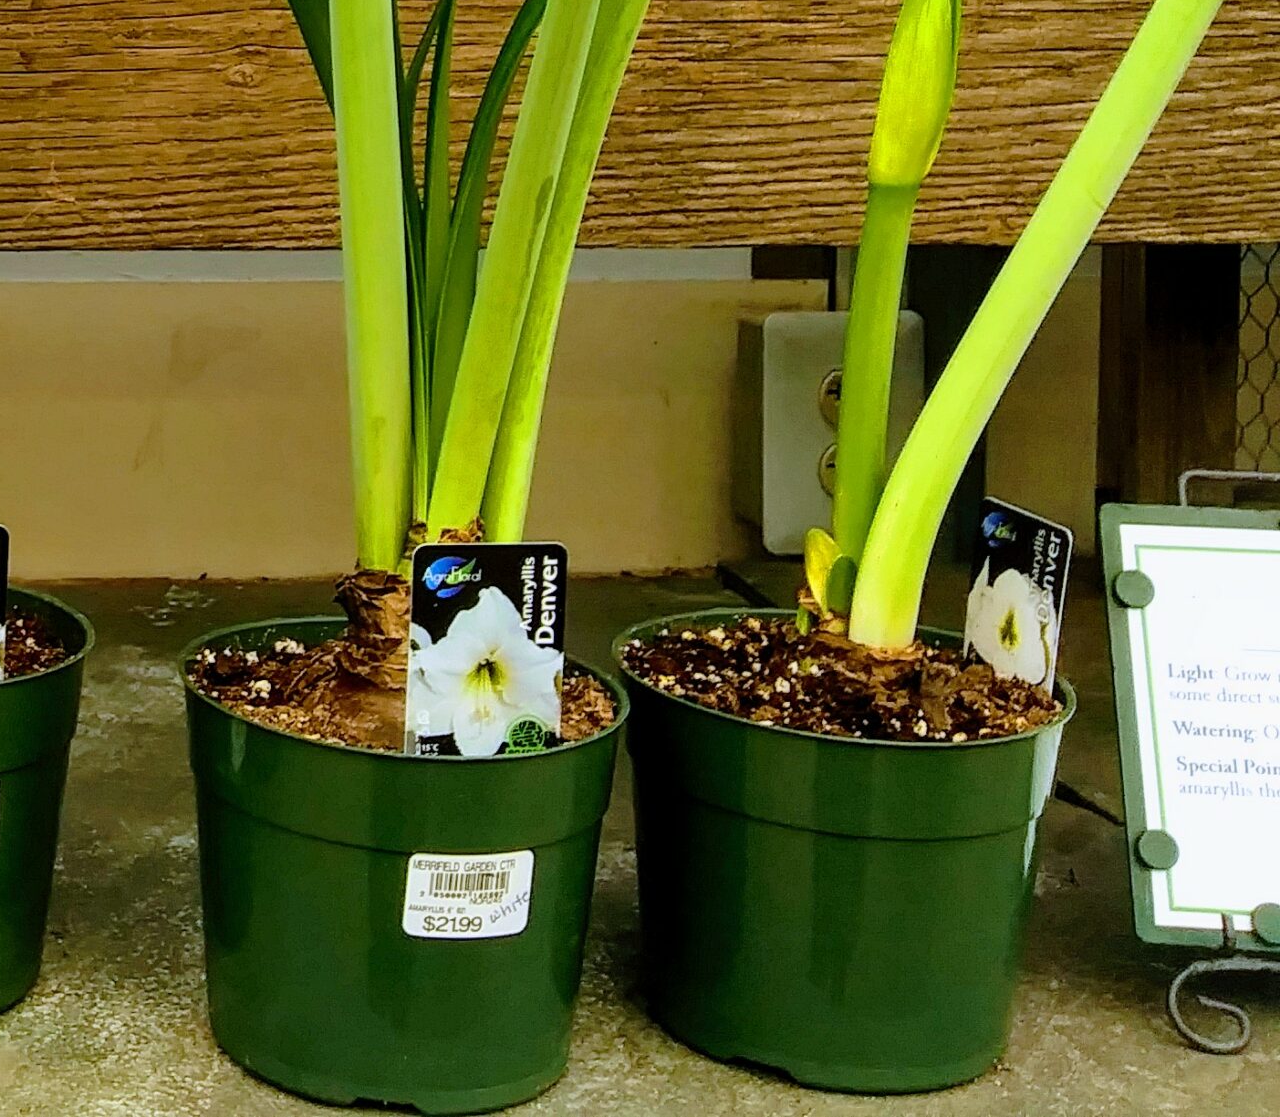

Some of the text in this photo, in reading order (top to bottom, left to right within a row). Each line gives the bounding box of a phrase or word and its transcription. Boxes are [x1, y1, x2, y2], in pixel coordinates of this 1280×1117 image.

[519, 556, 537, 632] Amaryllis
[535, 555, 559, 645] Denver
[1224, 665, 1272, 682] Grow
[1169, 690, 1211, 702] some
[1216, 686, 1262, 704] direct
[1176, 755, 1280, 777] Special Poin
[1178, 781, 1253, 801] amaryllis
[412, 858, 516, 872] MERRIFIELD GARDEN CTR
[490, 892, 530, 924] white
